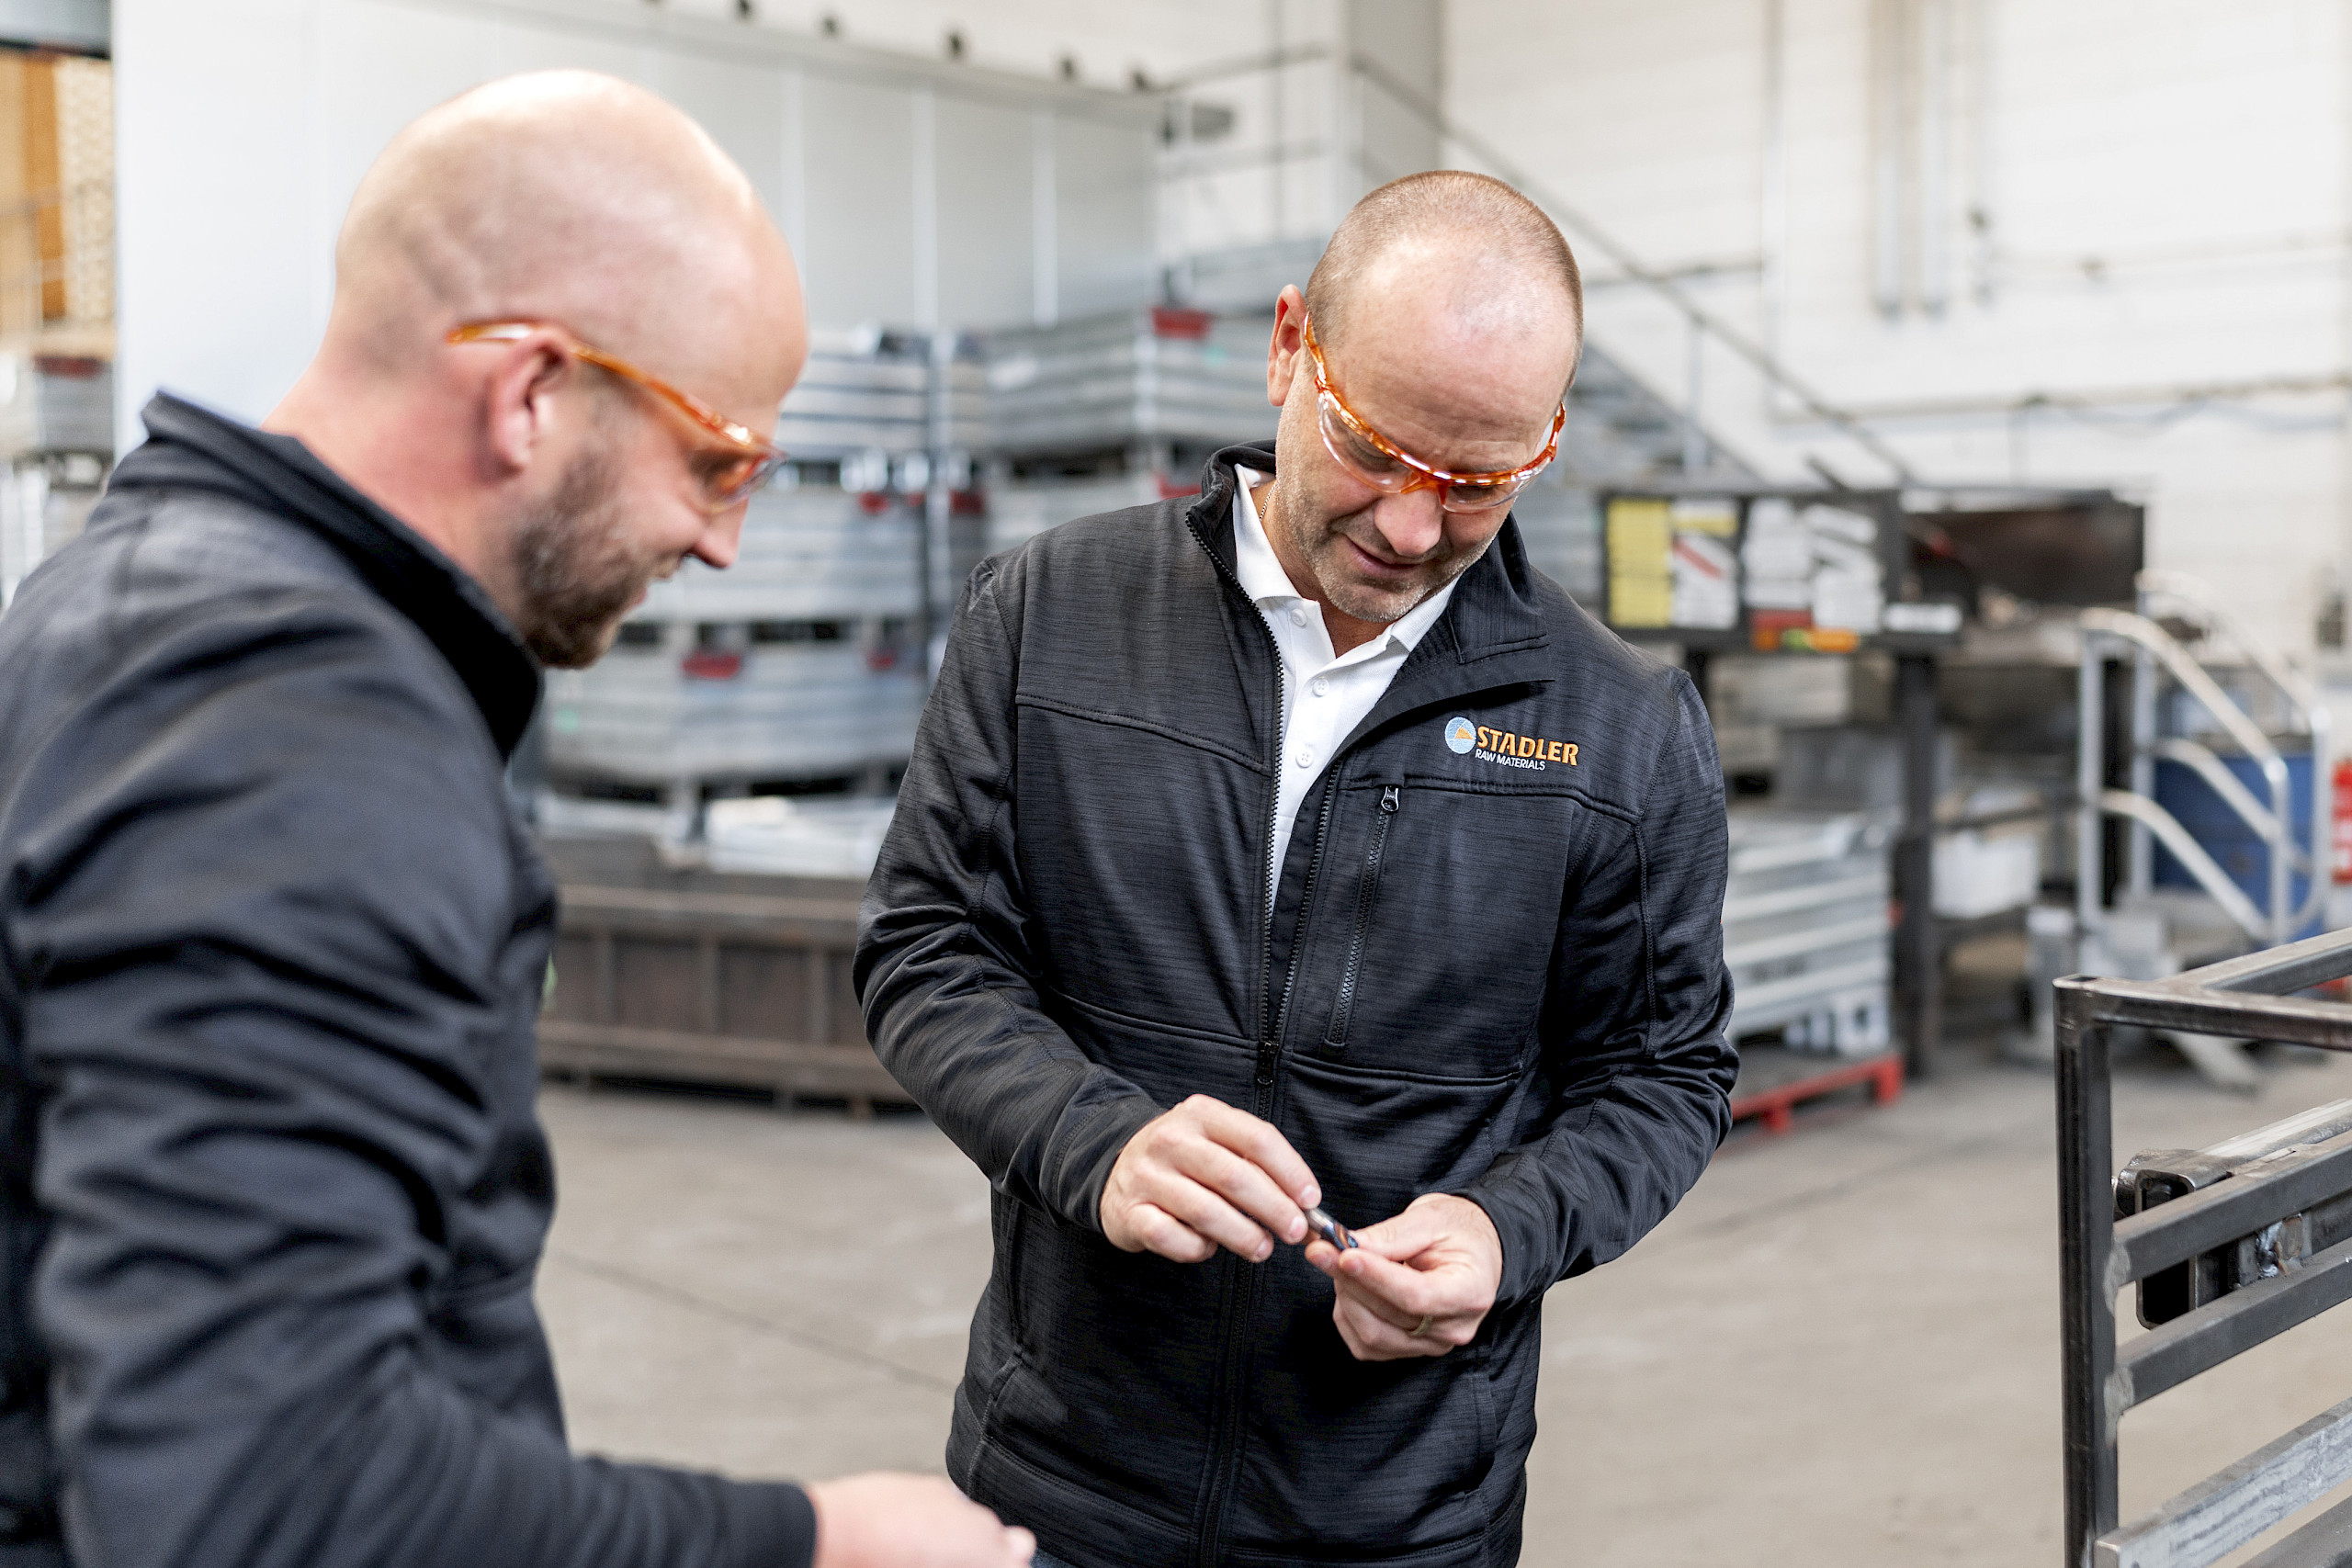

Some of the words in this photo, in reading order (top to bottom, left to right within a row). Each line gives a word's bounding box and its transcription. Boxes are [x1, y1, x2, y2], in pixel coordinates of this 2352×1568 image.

[1475, 748, 1498, 762] RAW
[1497, 753, 1546, 771] MATERIALS
[1477, 726, 1579, 766] STADLER
